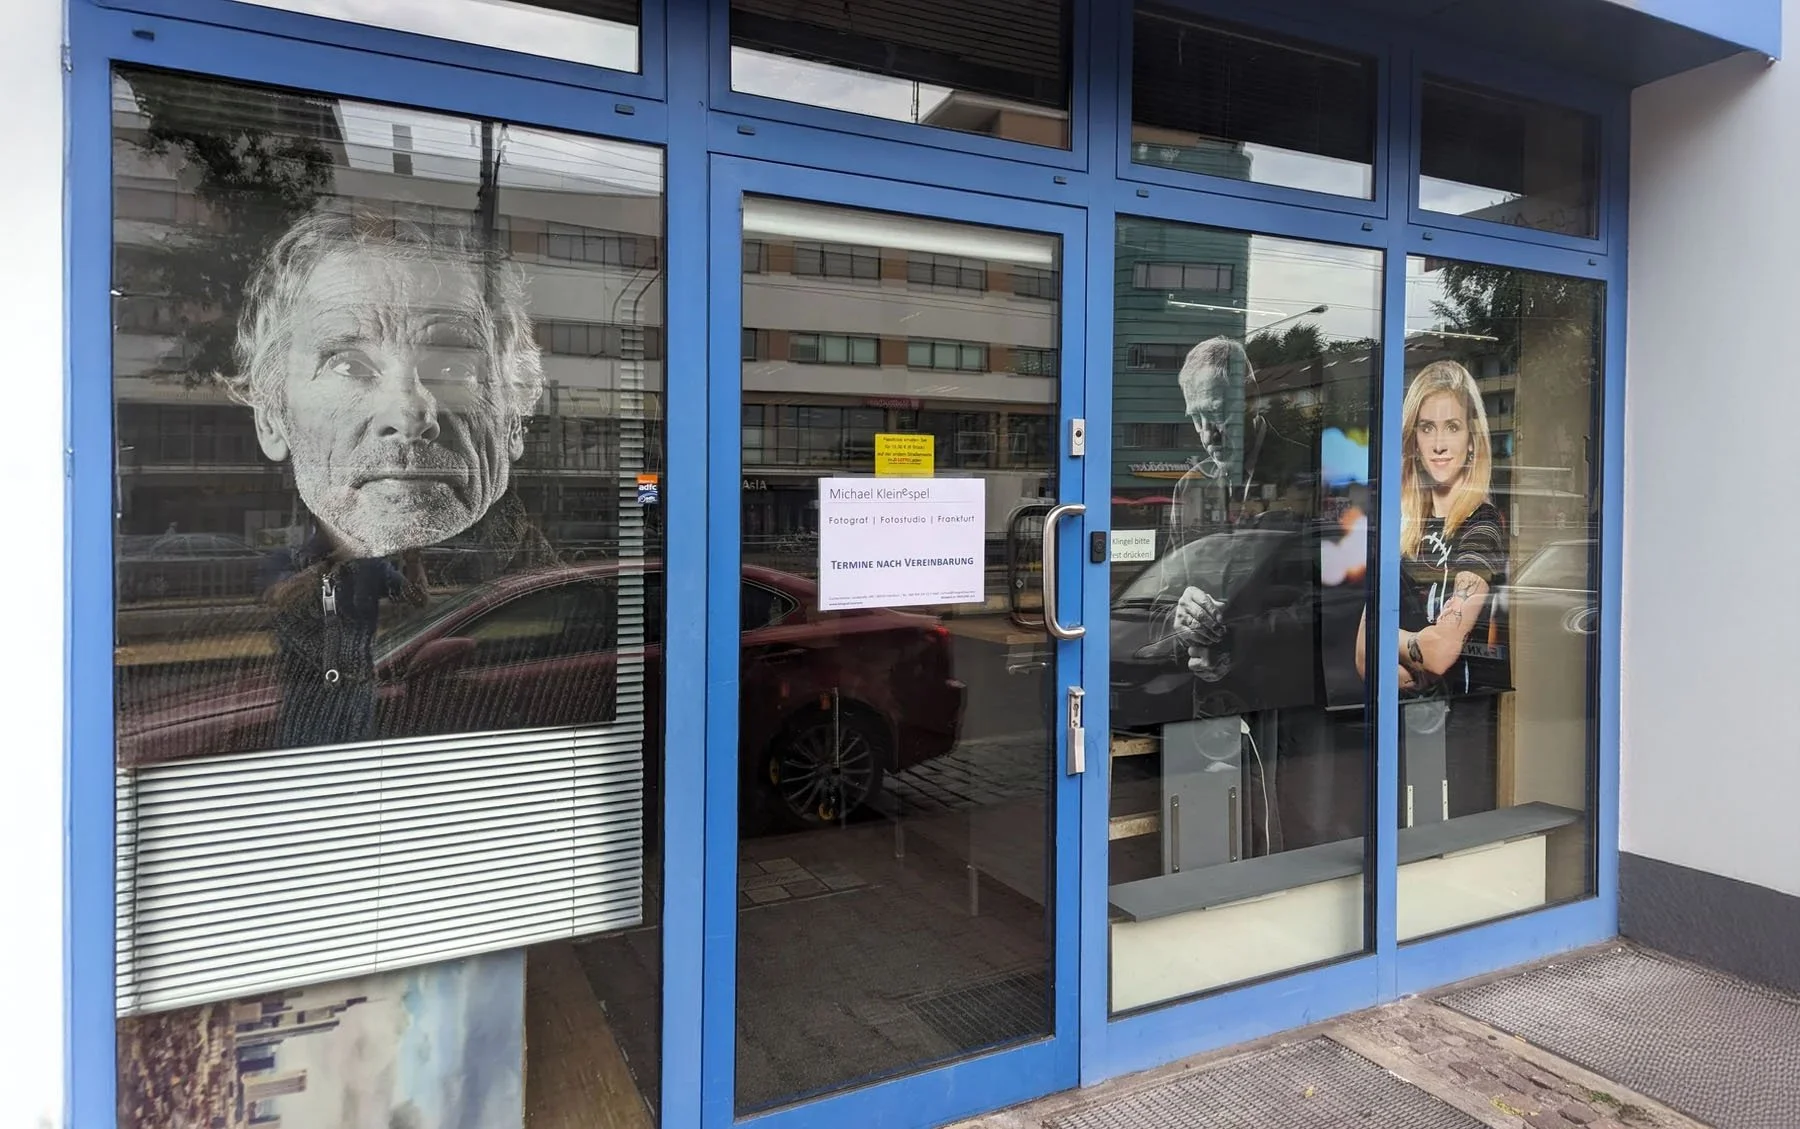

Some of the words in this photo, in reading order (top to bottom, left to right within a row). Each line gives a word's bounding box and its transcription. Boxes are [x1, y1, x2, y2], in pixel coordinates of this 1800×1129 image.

[830, 488, 873, 499] Michael
[877, 487, 930, 501] Kleinespel
[828, 516, 868, 525] Fotograf
[880, 515, 926, 523] Fotostudio
[938, 515, 975, 523] Frankfurt
[1134, 537, 1150, 545] bitte
[1123, 550, 1152, 559] drücken!
